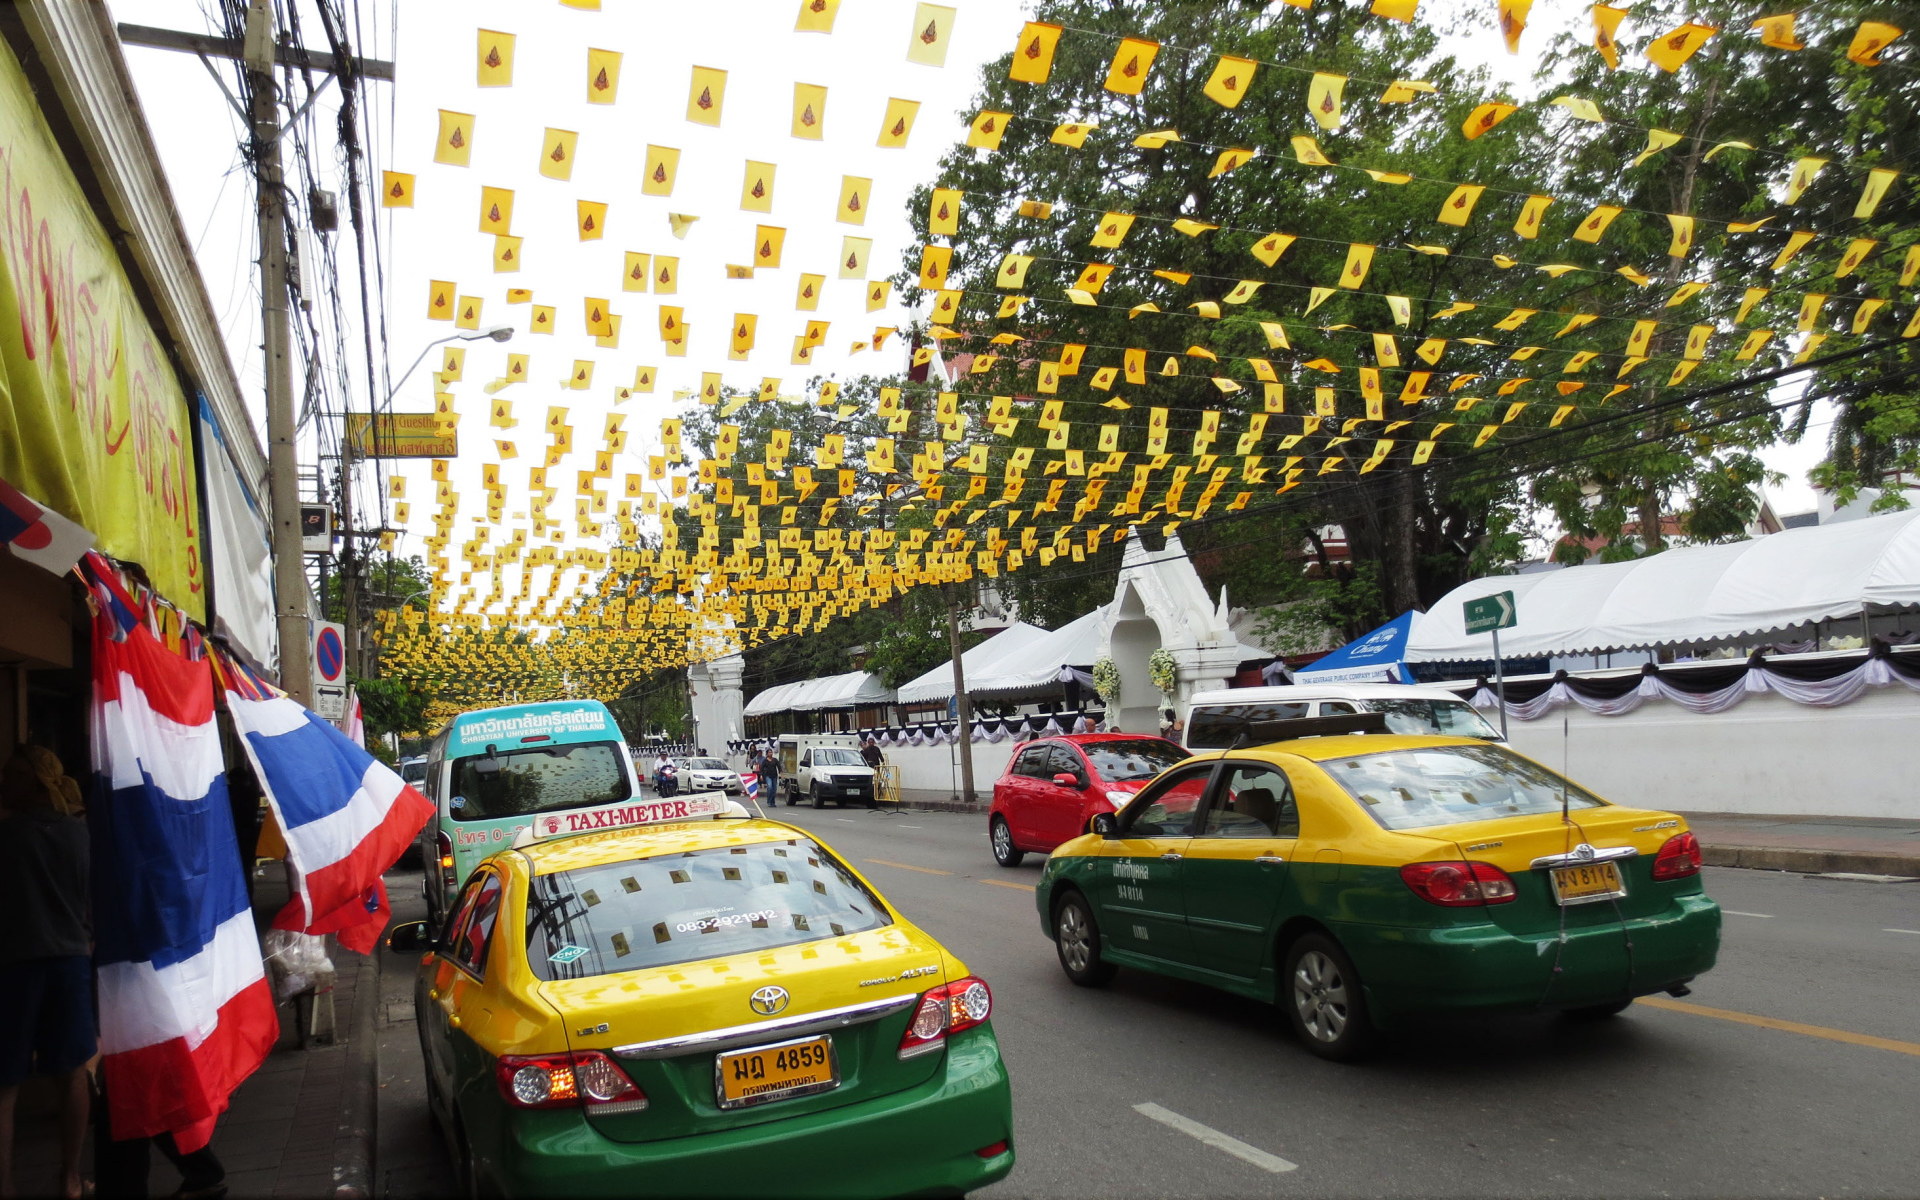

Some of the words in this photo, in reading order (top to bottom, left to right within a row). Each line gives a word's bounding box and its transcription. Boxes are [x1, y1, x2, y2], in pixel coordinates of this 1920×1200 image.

[1349, 672, 1371, 680] COMPANY
[460, 708, 604, 737] มหาวิทยาลัยคริสเตียน
[461, 733, 504, 744] CHRISTIAN
[506, 728, 552, 738] UNIVERSITY
[568, 723, 605, 732] THAILAND
[566, 801, 689, 831] TAXI-METER
[454, 826, 486, 845] โทร
[1581, 865, 1615, 885] 8114
[676, 909, 778, 933] 083-2921912
[556, 948, 581, 959] CNG
[859, 975, 897, 987] COROLLA
[897, 964, 938, 981] ALTIS
[776, 1044, 825, 1072] 4859
